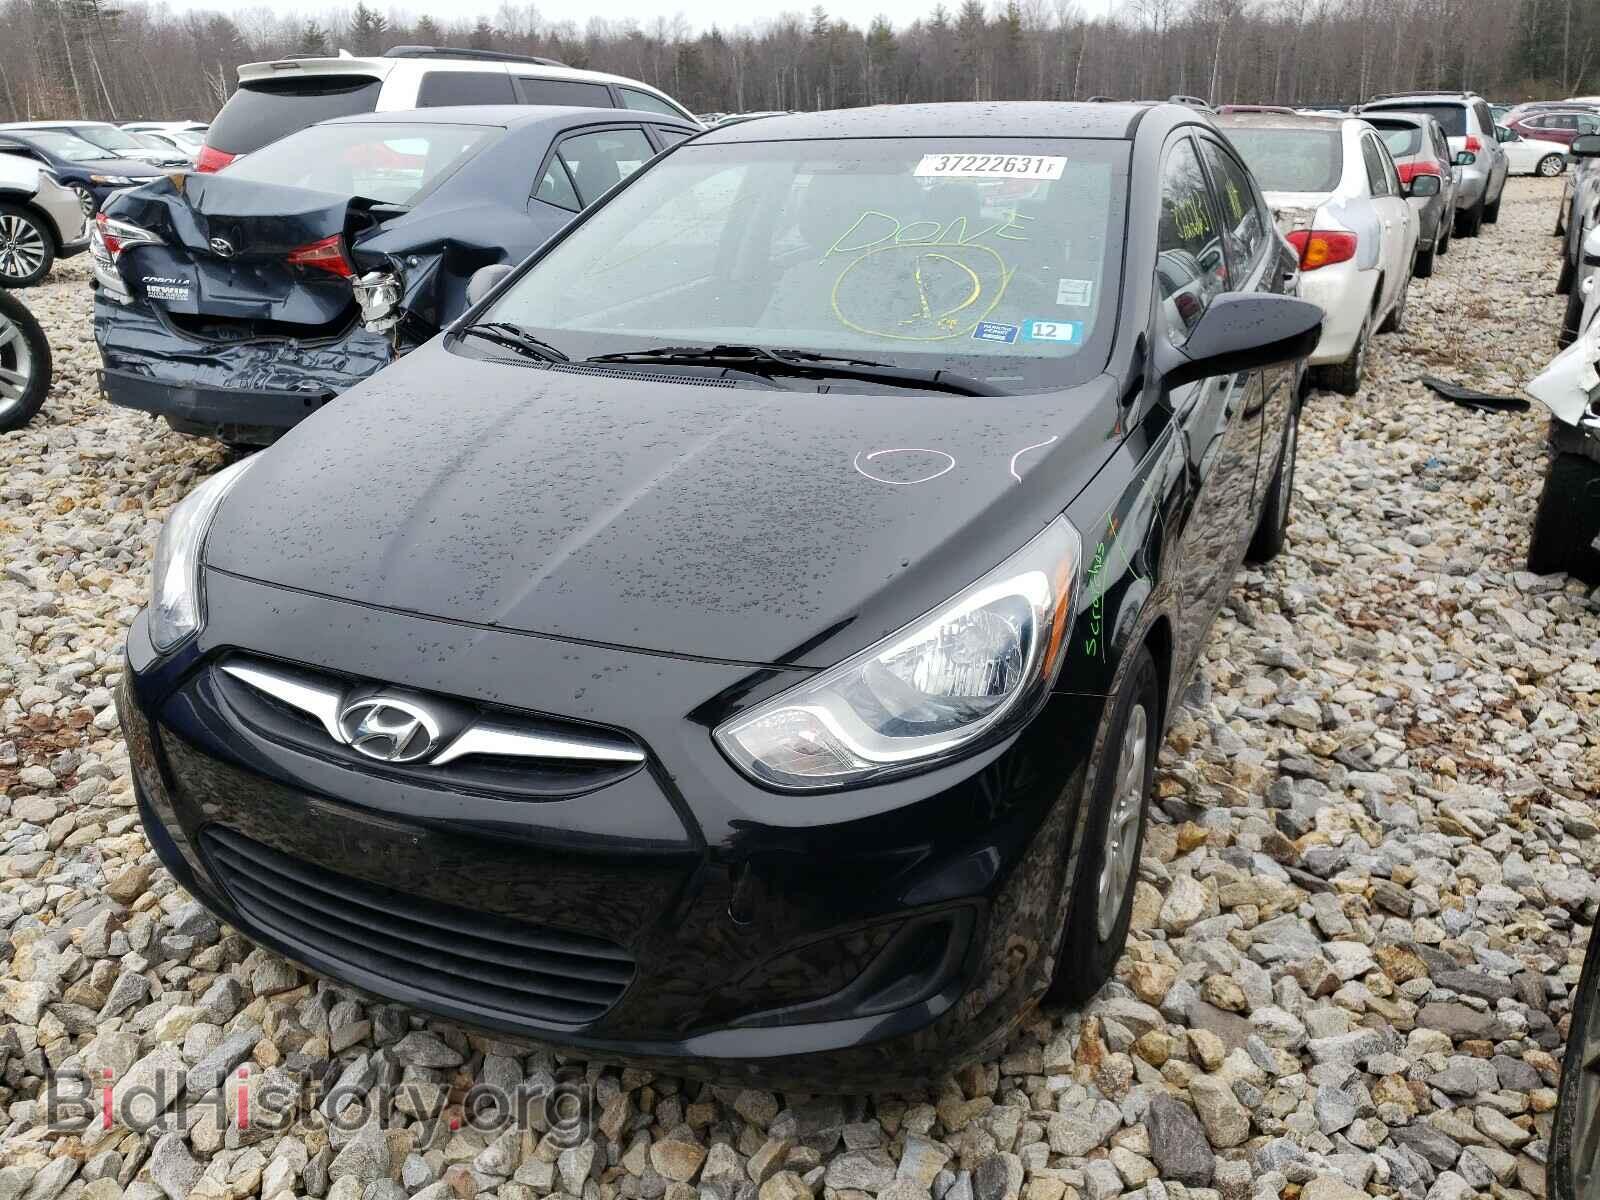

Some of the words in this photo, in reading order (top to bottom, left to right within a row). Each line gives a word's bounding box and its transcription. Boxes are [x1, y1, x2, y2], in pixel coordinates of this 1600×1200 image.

[935, 155, 1044, 174] 37222631
[819, 210, 1034, 265] DONE
[142, 276, 190, 284] COROLLA
[1033, 323, 1057, 338] 12
